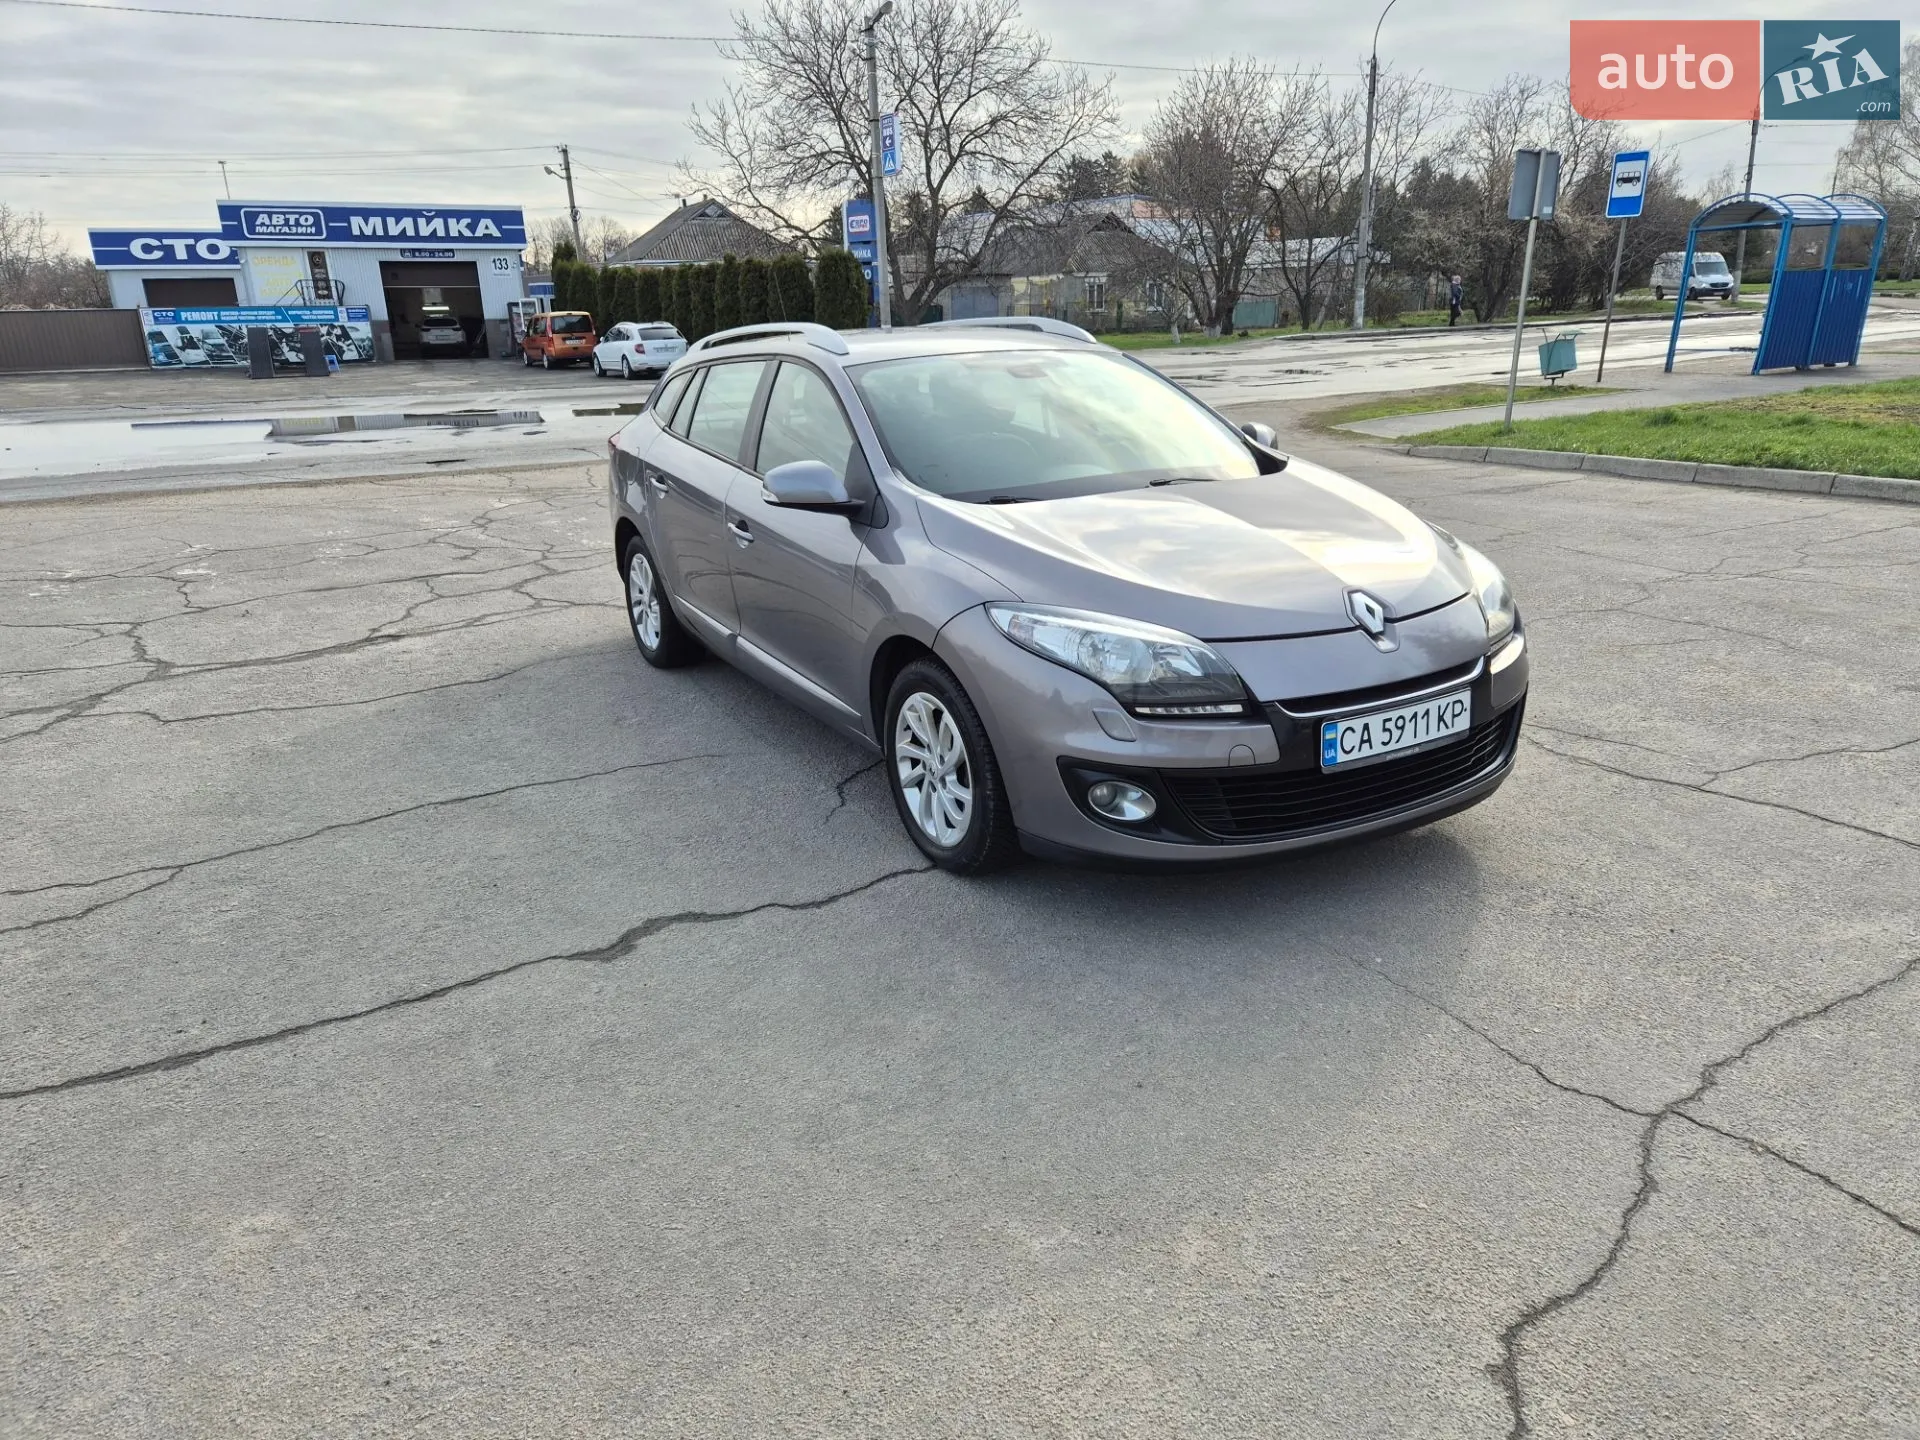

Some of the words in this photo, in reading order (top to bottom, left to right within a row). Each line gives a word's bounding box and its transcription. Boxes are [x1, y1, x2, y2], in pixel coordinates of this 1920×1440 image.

[255, 213, 315, 226] АВТО
[350, 211, 502, 238] МИЙКА
[255, 226, 316, 235] МАГАЗИН
[129, 237, 231, 260] СТО
[492, 258, 509, 271] 133
[180, 311, 218, 321] РЕМОНТ
[1340, 722, 1373, 755] CA
[1381, 708, 1431, 747] 5911
[1437, 699, 1465, 733] KP
[1324, 749, 1336, 759] UA
